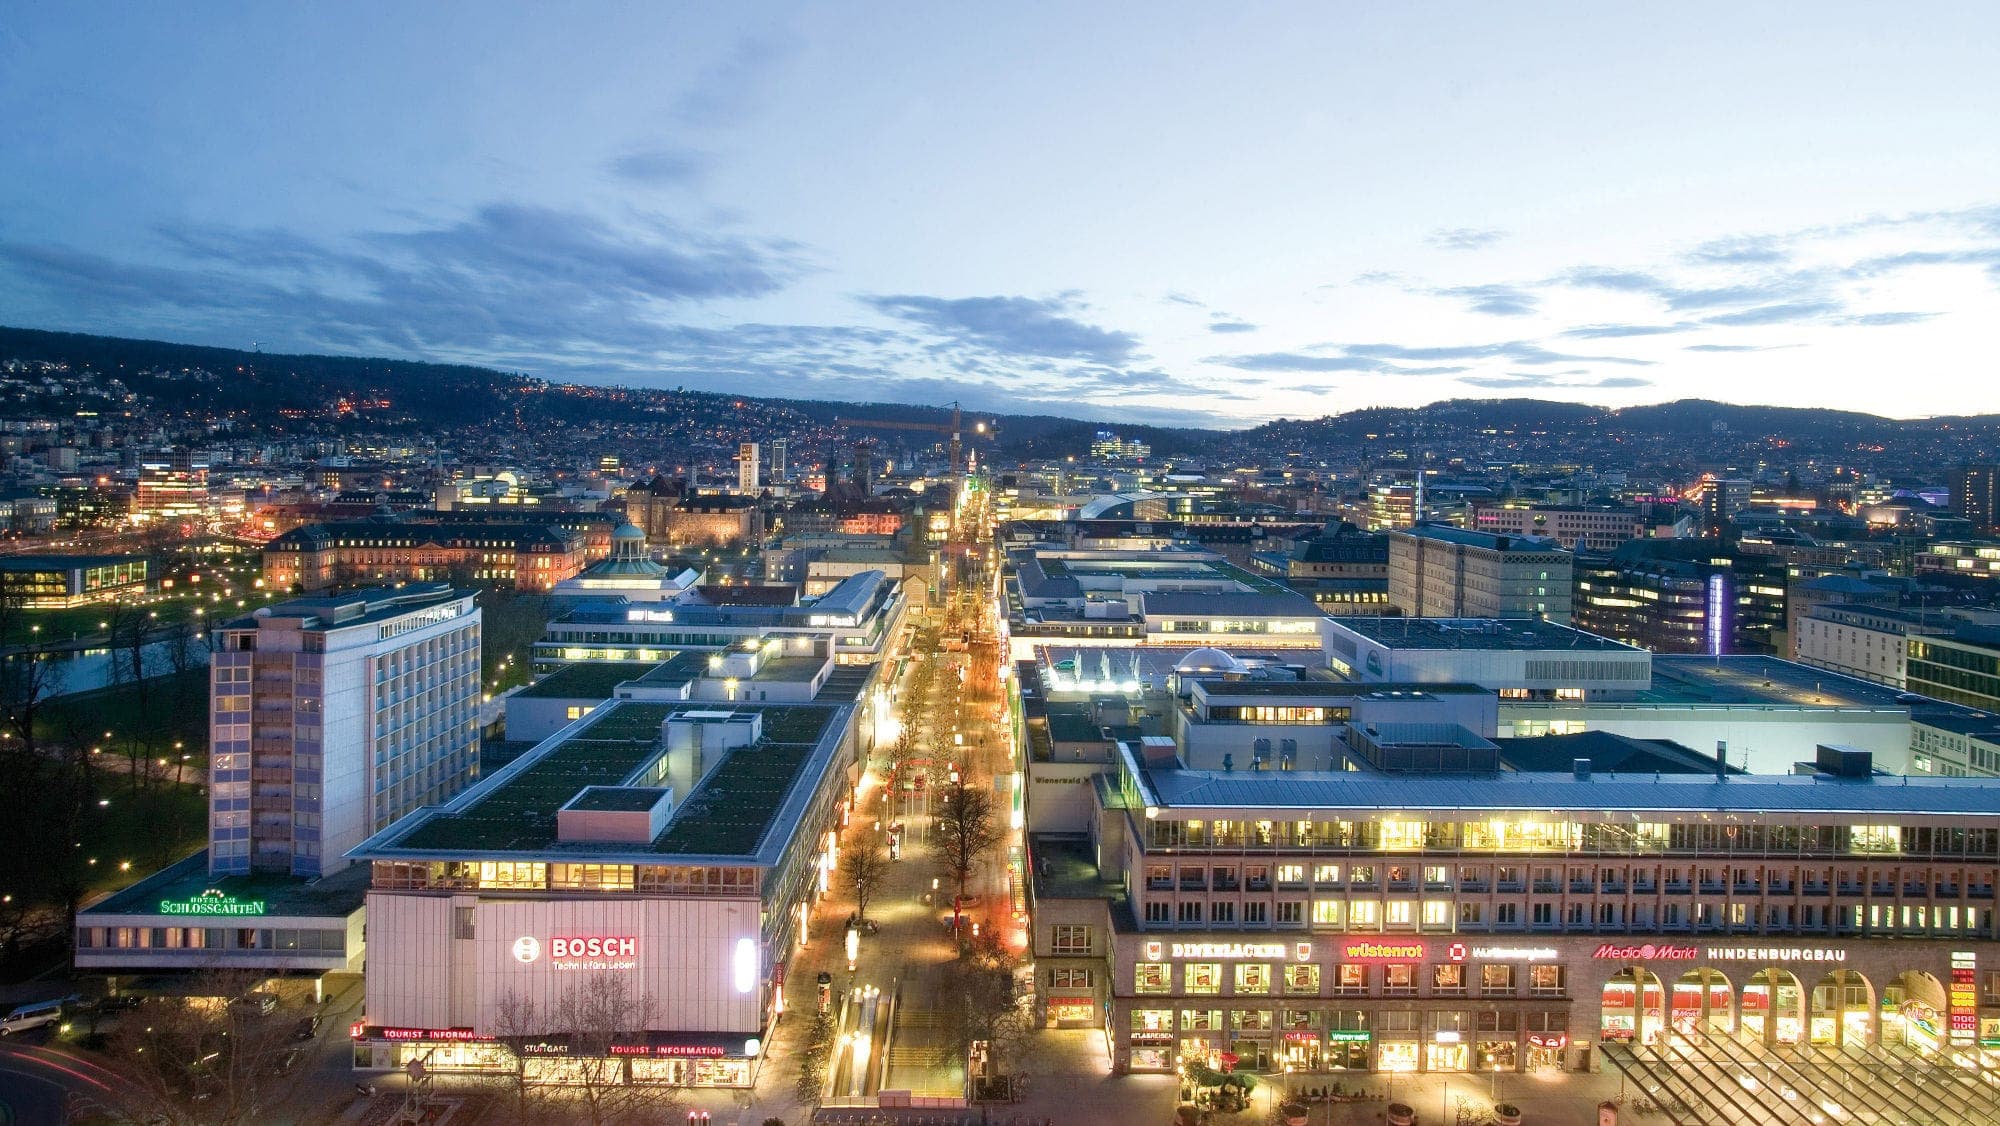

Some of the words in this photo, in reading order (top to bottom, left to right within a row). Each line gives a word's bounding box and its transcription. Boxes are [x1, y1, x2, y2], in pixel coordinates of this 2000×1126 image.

[552, 938, 635, 957] BOSCH
[1346, 943, 1423, 958] wüstenrot
[1707, 947, 1846, 961] HINDENBURGBAU
[384, 1030, 424, 1038] TOURIST
[610, 1046, 650, 1054] TOURIST
[657, 1046, 725, 1055] INFORMATION
